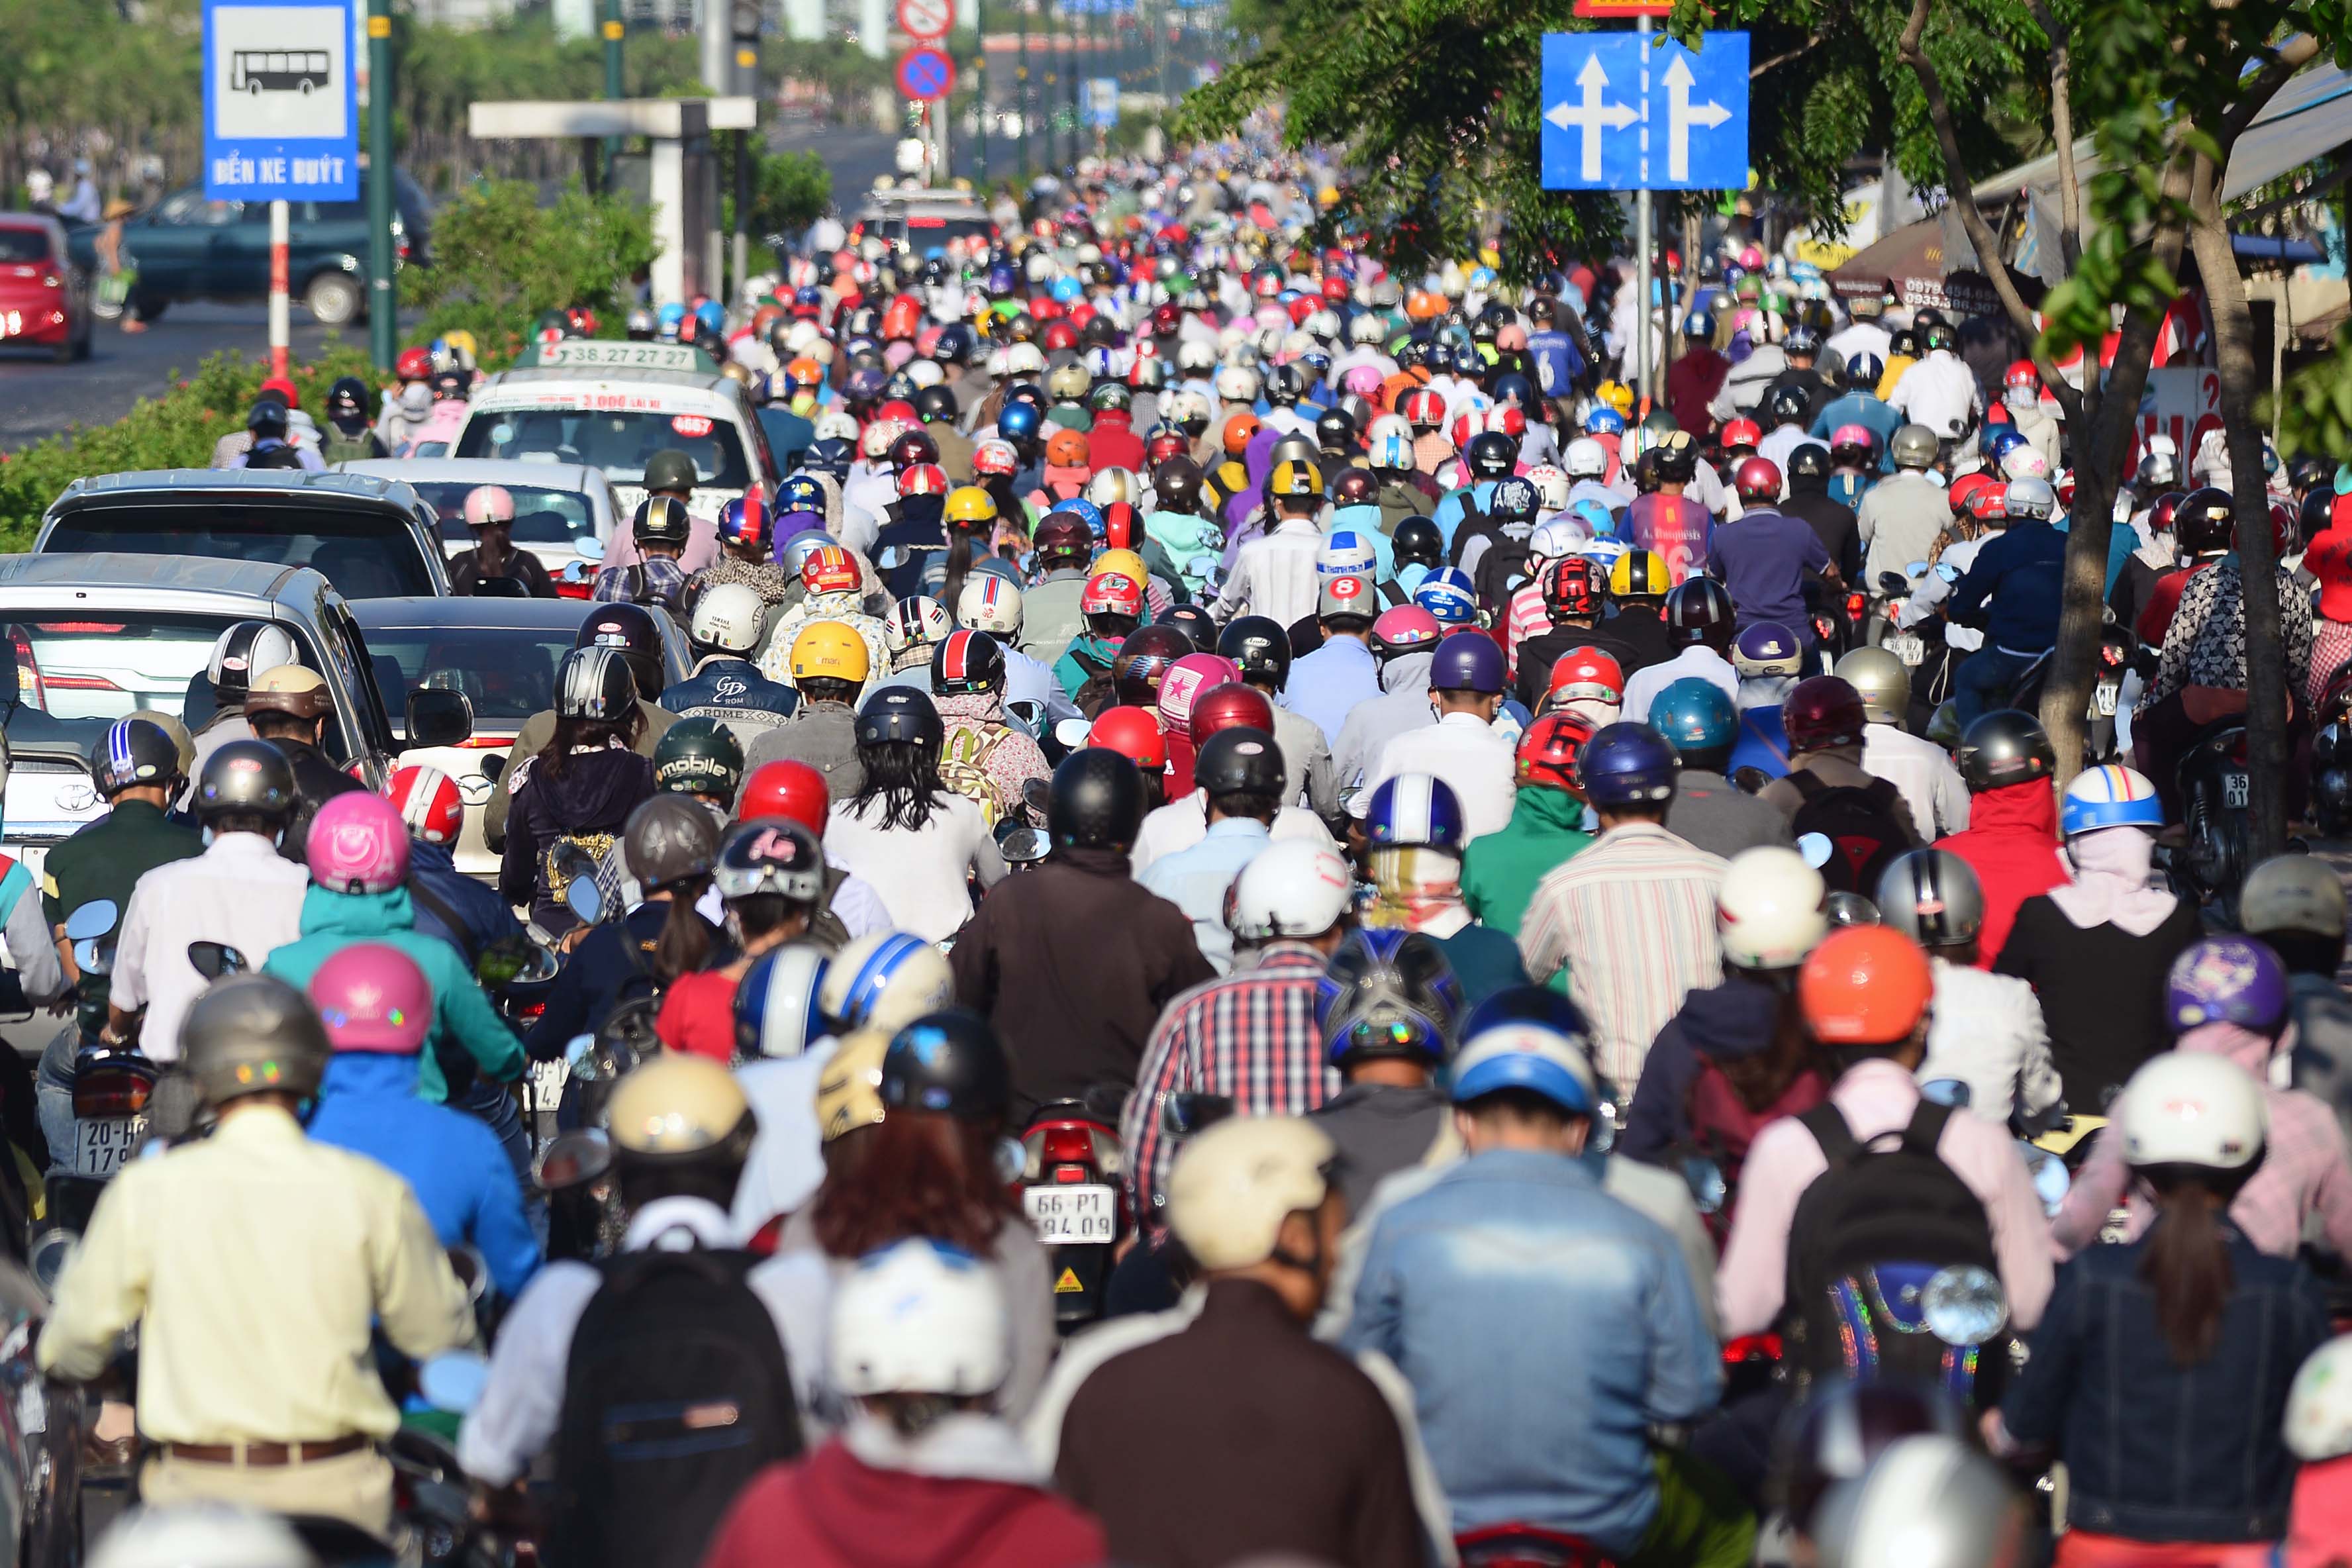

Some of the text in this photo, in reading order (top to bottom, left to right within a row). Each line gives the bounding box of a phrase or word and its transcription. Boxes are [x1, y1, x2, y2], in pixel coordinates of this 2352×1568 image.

[260, 158, 286, 184] XE
[1539, 350, 1555, 391] 6
[1336, 579, 1354, 594] 8
[711, 615, 730, 625] YAMAHA
[661, 756, 727, 777] mobile
[2230, 775, 2247, 789] 36
